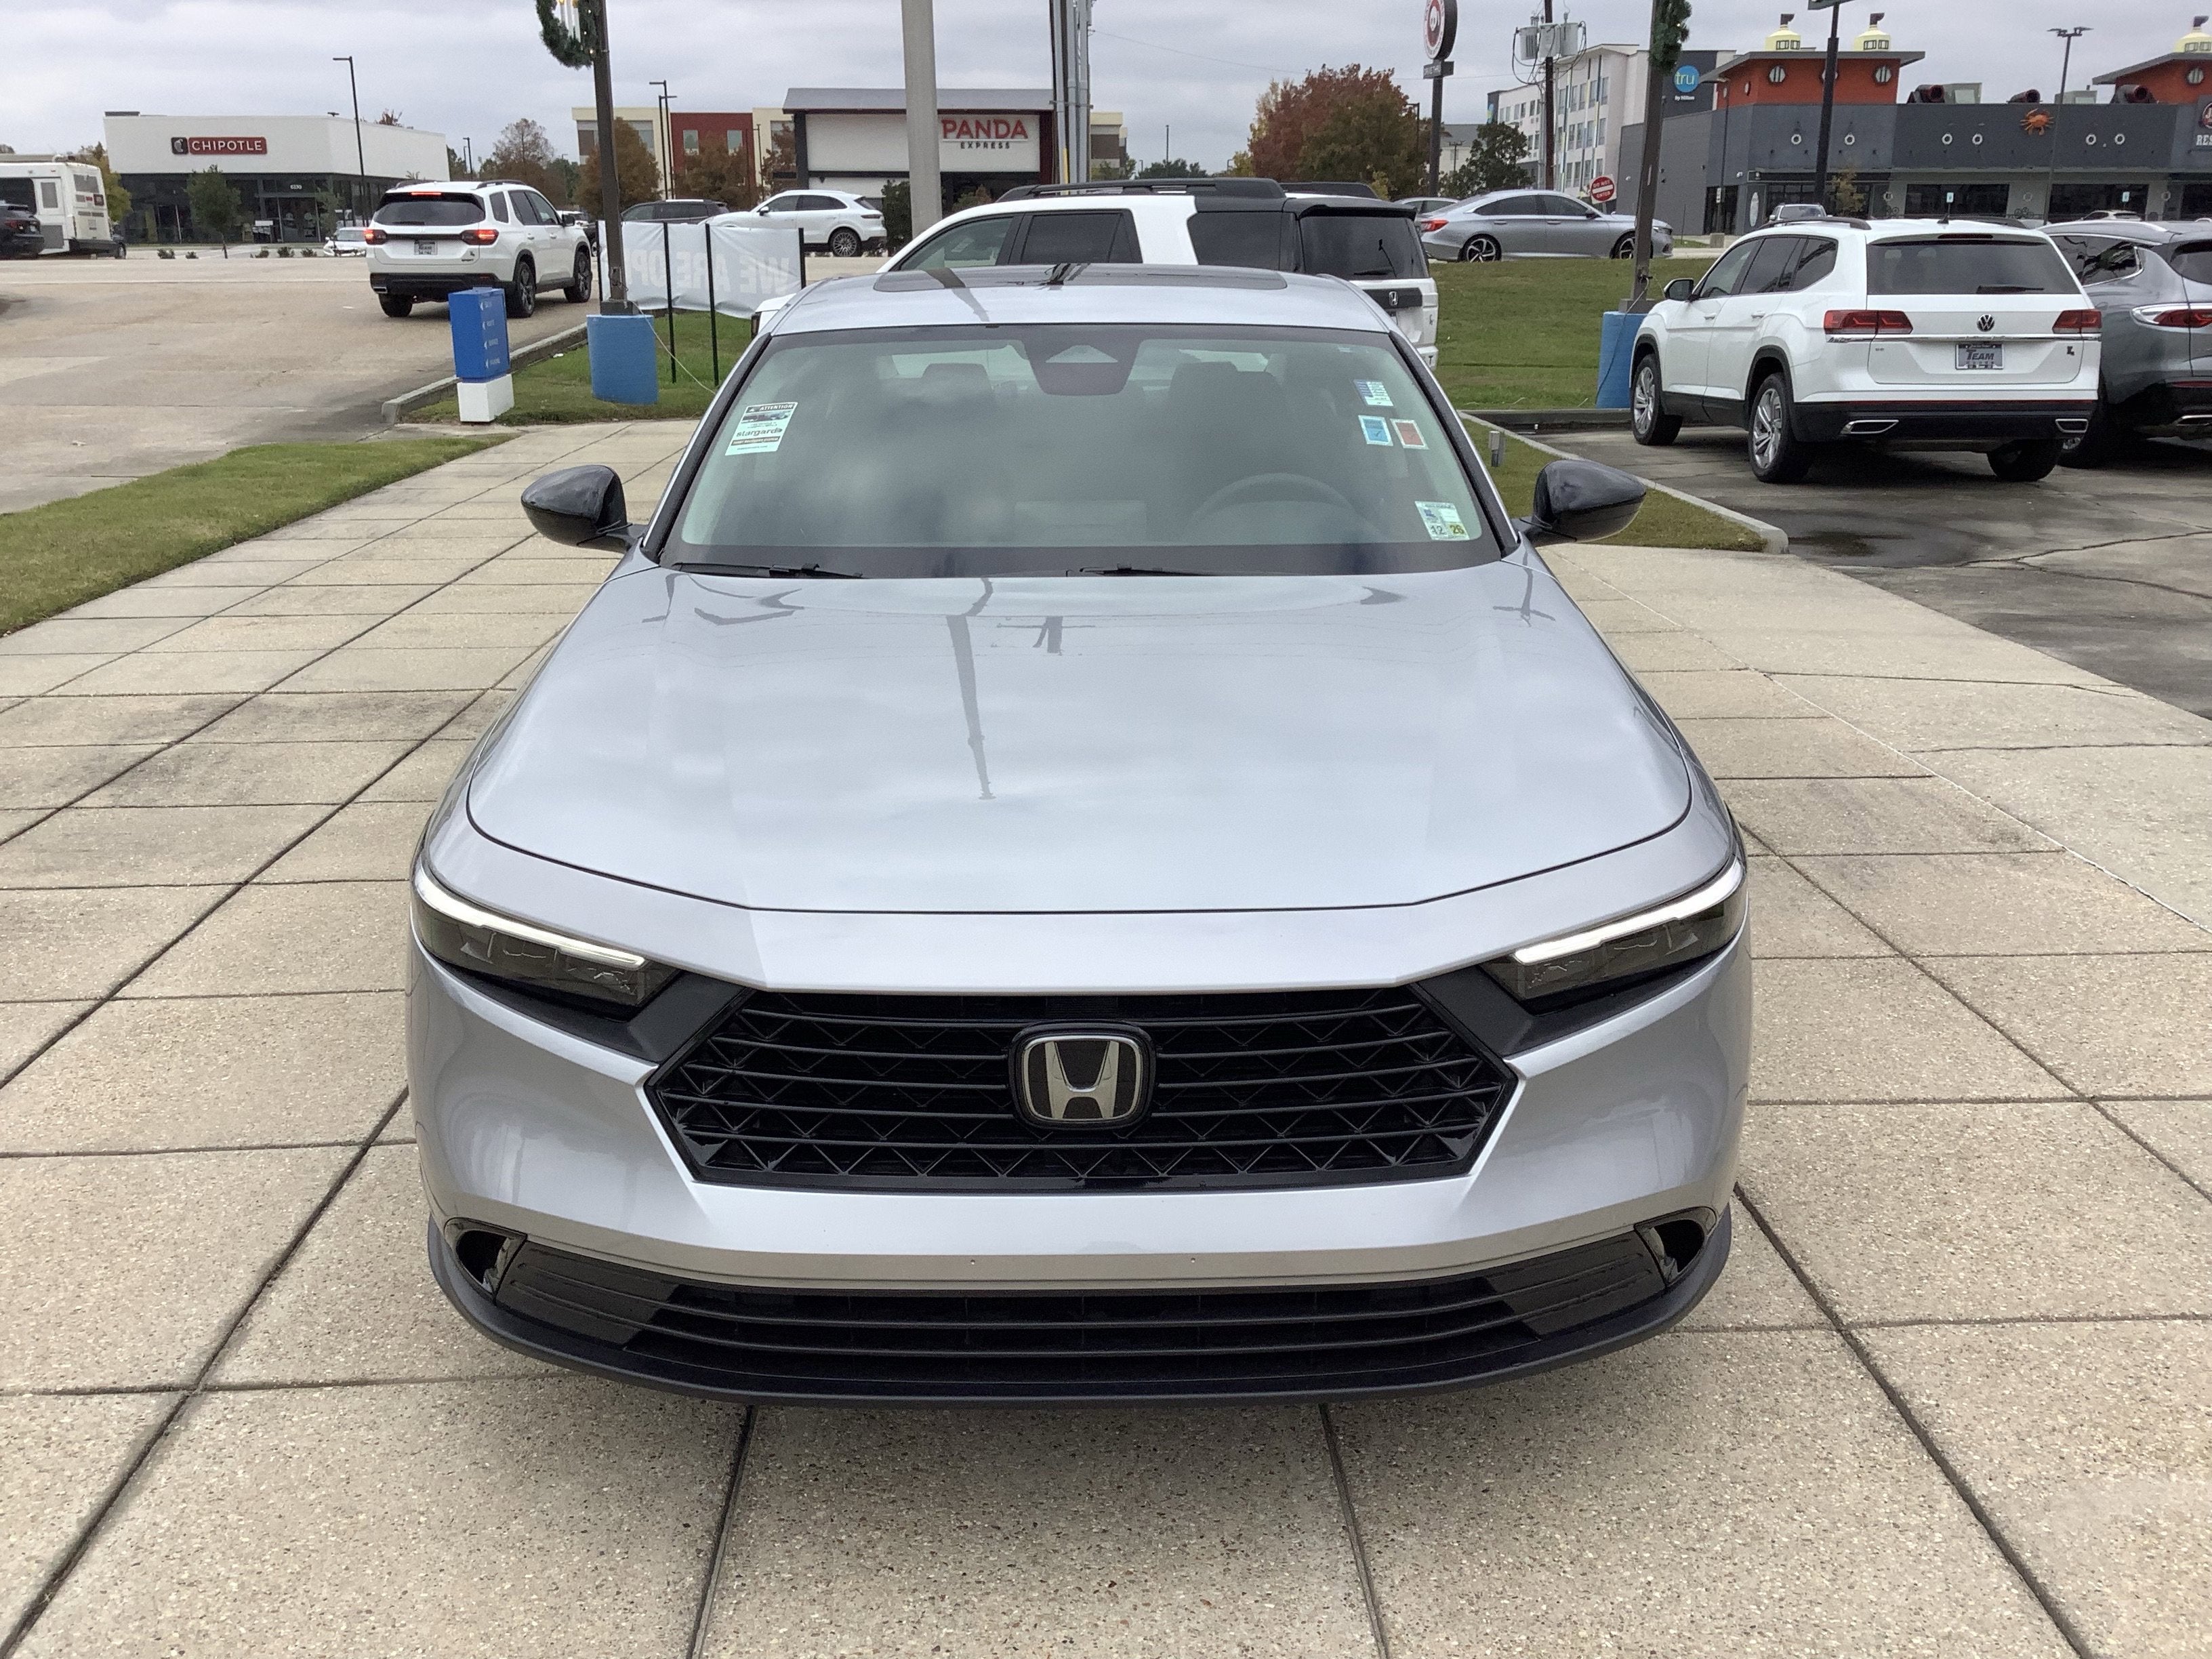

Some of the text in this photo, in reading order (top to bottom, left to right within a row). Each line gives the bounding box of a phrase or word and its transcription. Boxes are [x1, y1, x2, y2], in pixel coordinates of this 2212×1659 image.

[1675, 72, 1695, 85] tru
[941, 119, 1028, 139] PANDA
[192, 141, 262, 150] CHIPOTLE
[1966, 350, 1994, 360] TEAM
[737, 428, 777, 437] stargard
[1431, 526, 1447, 535] 12
